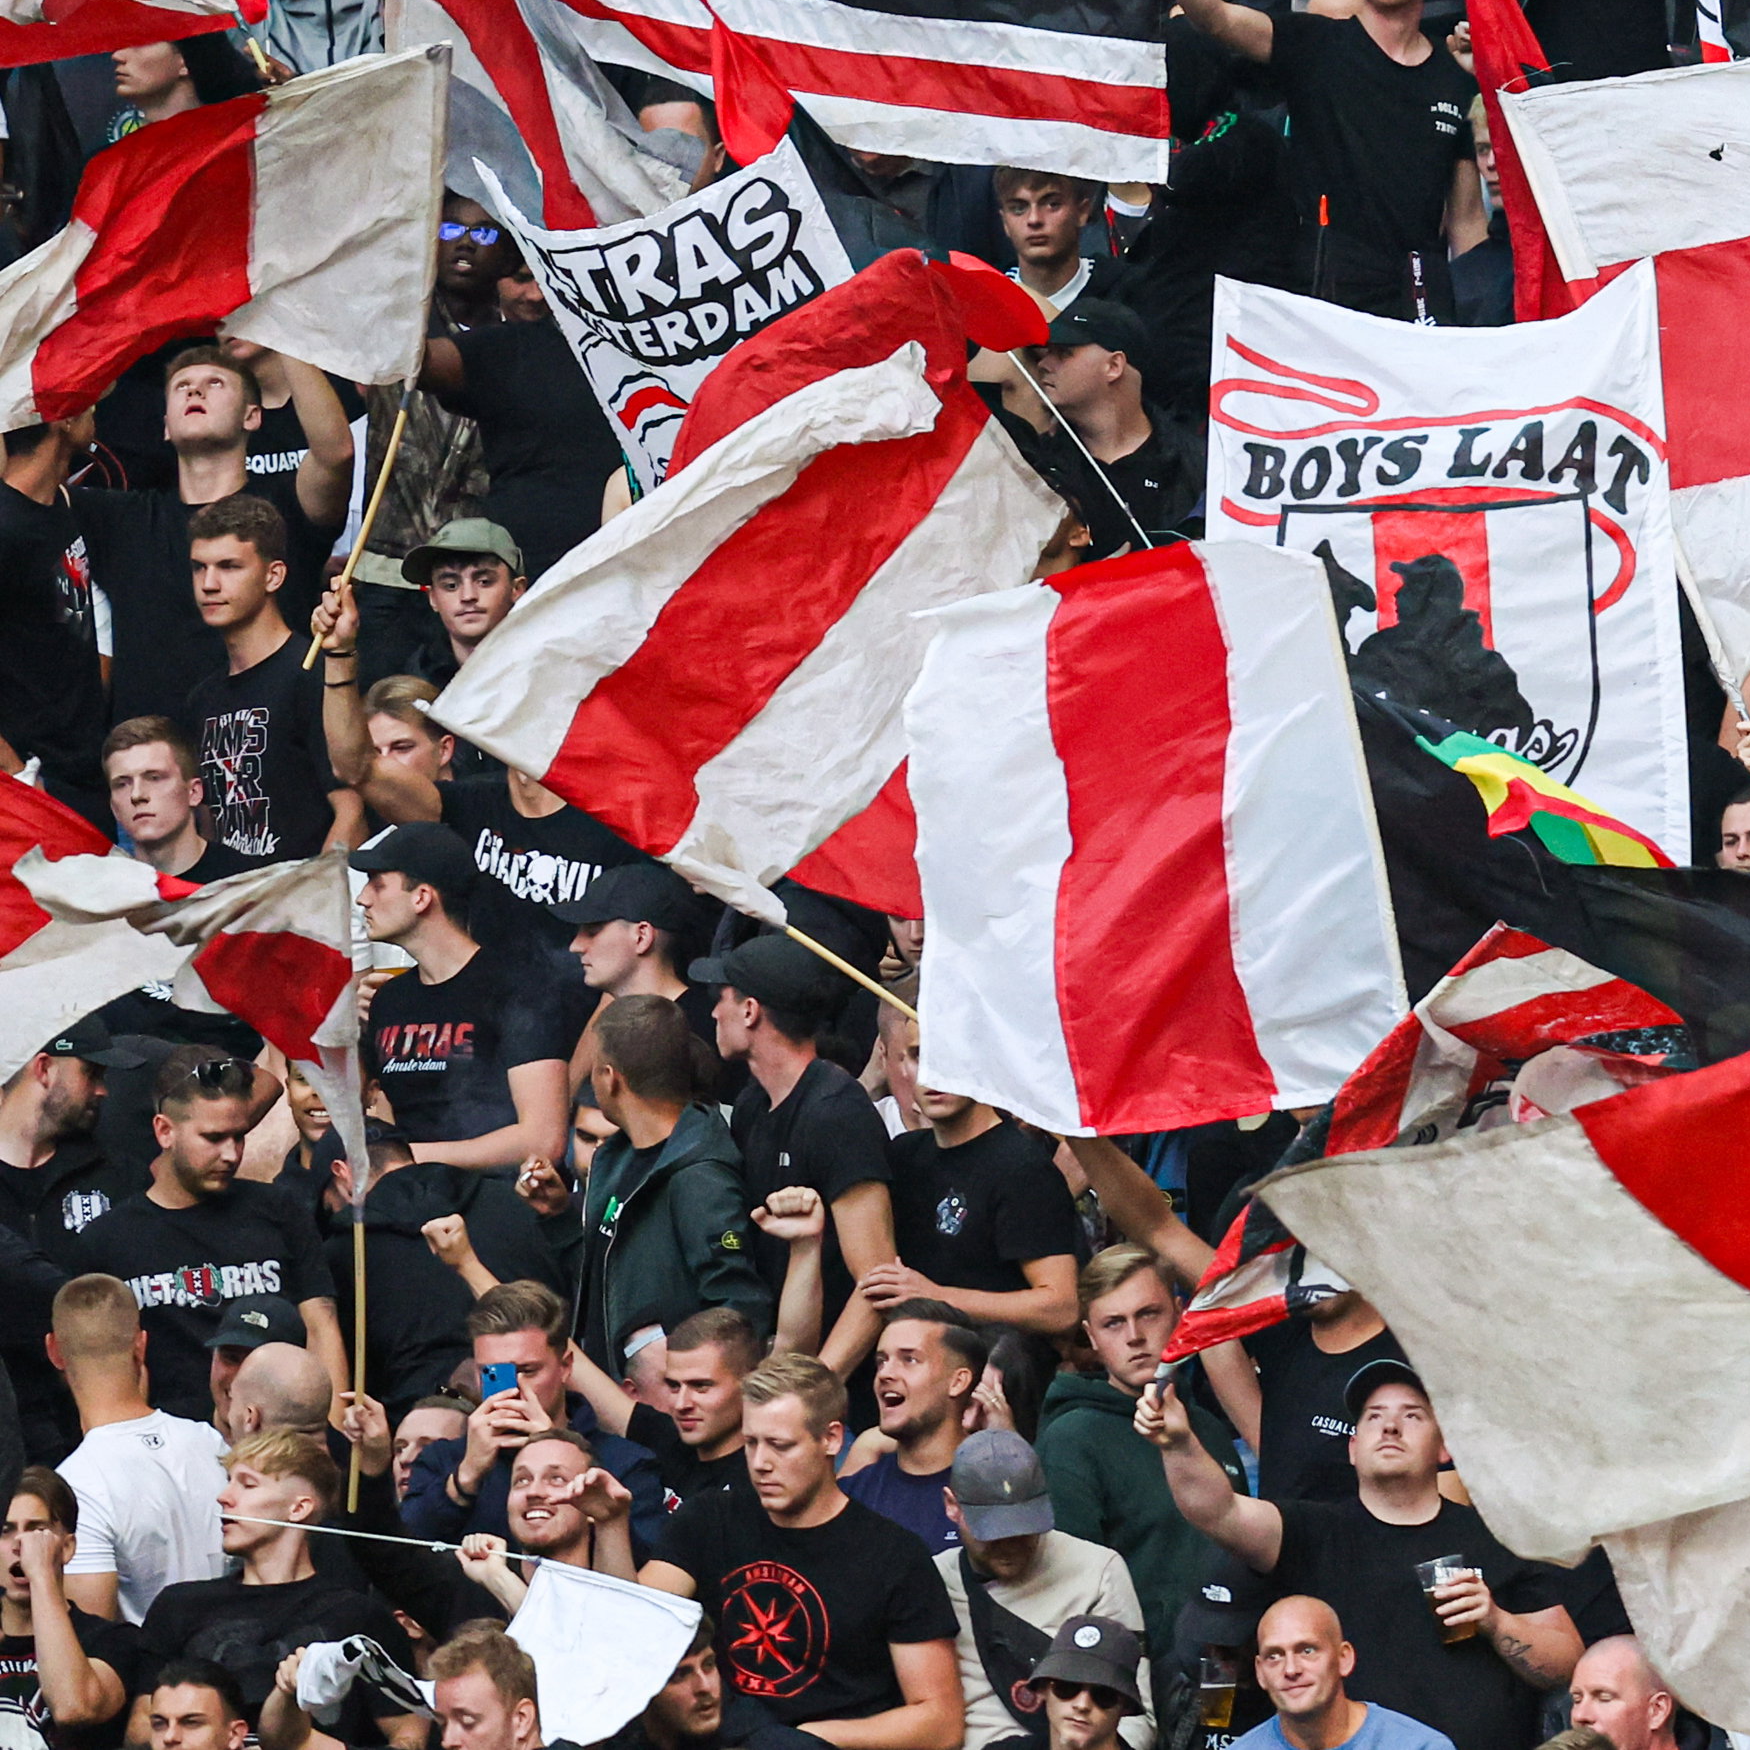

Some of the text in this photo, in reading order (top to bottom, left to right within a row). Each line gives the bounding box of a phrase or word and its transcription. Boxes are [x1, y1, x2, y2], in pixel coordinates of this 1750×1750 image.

[546, 179, 797, 318] TRAS
[1242, 420, 1651, 516] BOYS LAAT
[382, 1057, 448, 1074] Amsterdam
[1310, 1414, 1356, 1437] CASUALS
